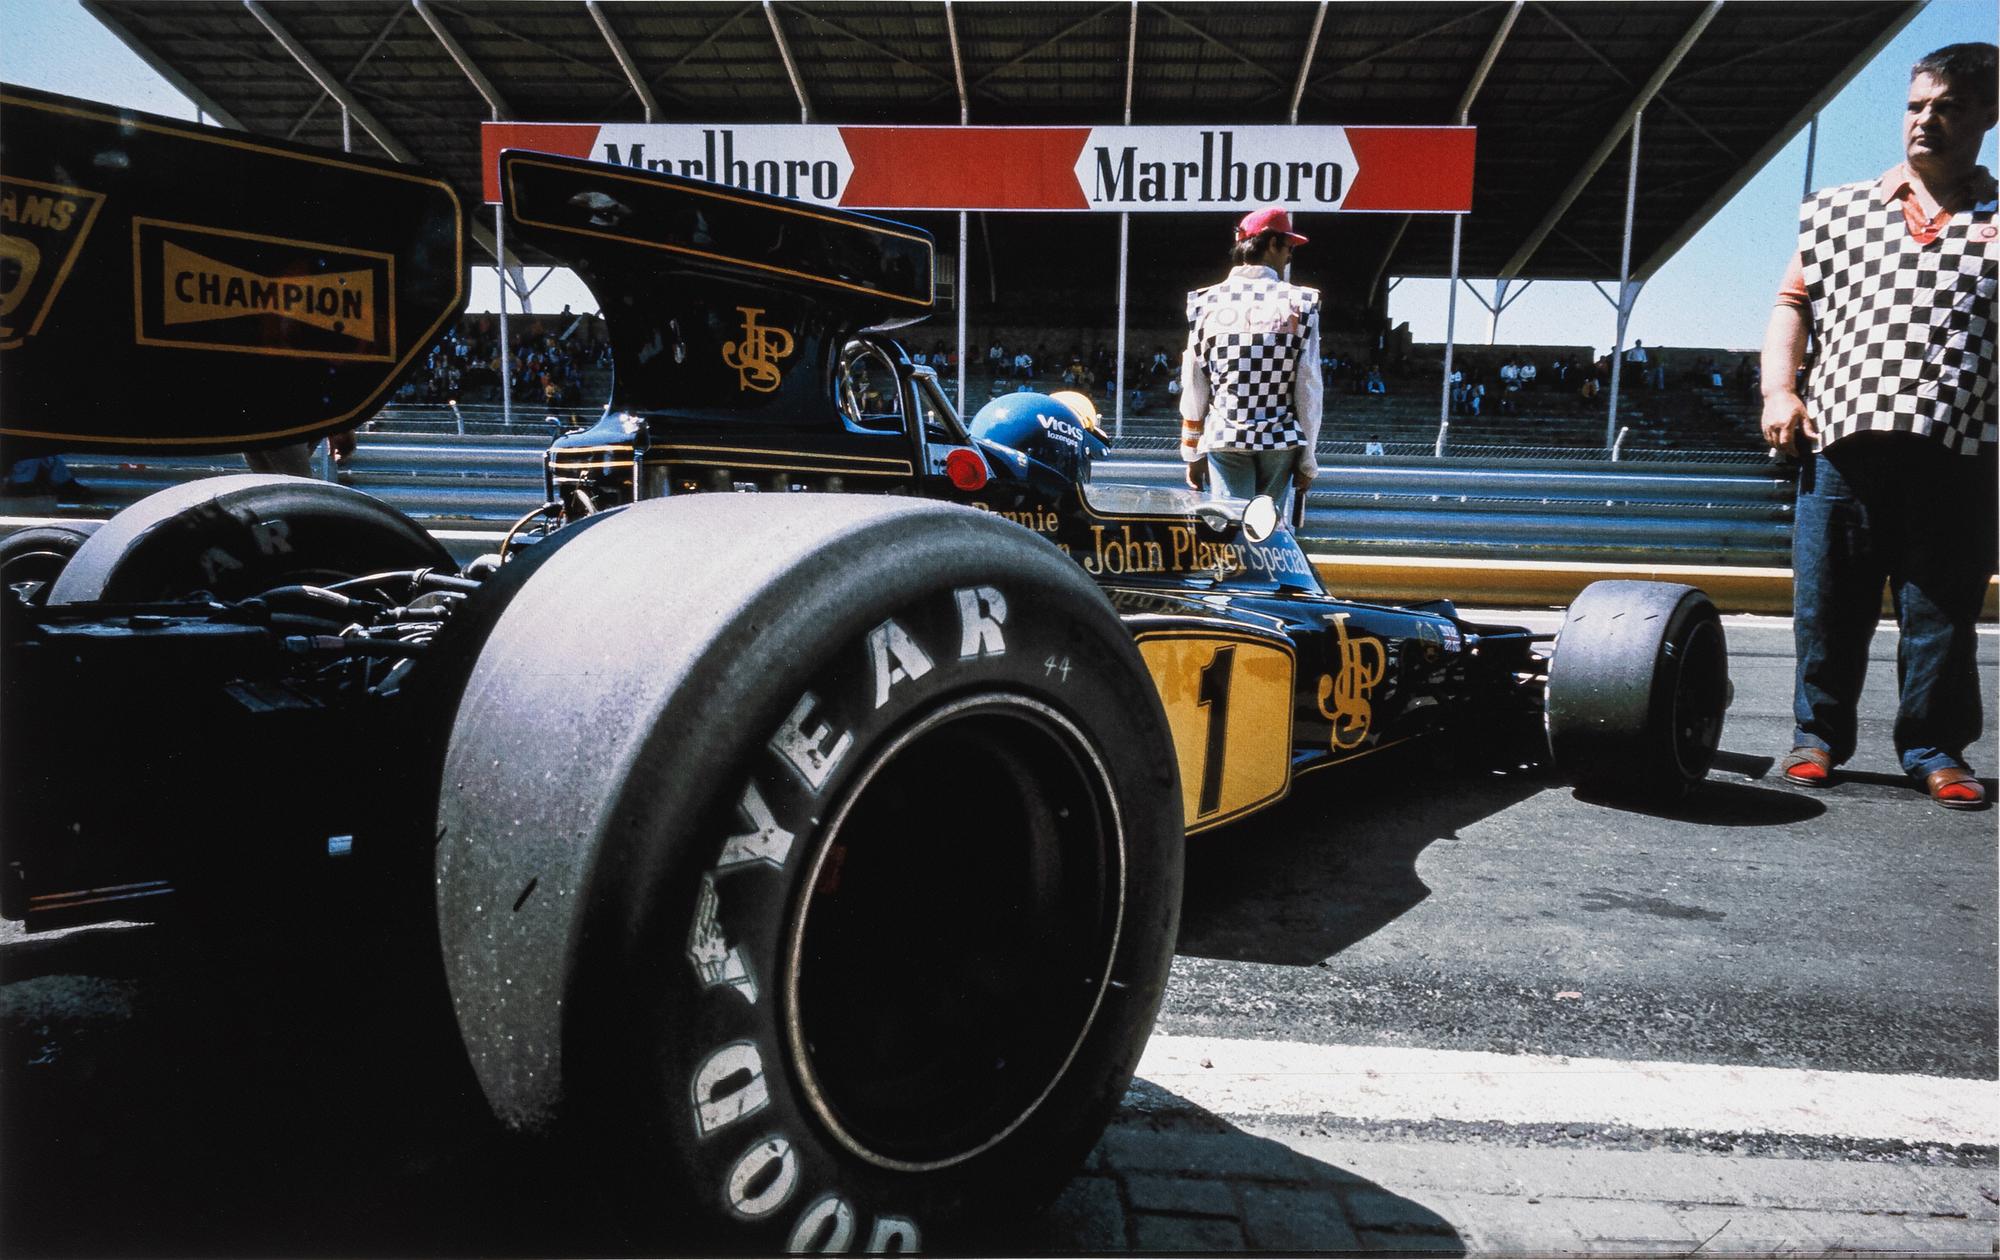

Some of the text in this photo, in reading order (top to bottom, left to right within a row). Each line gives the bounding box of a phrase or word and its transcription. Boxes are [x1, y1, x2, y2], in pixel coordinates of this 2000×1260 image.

[1093, 131, 1343, 203] Marlboro
[175, 270, 363, 320] CHAMPION
[1037, 414, 1083, 440] VICKS
[971, 502, 1059, 532] nnie
[1084, 525, 1166, 575] John
[1168, 526, 1248, 582] Player
[1043, 655, 1073, 683] 44
[1197, 645, 1238, 820] 1
